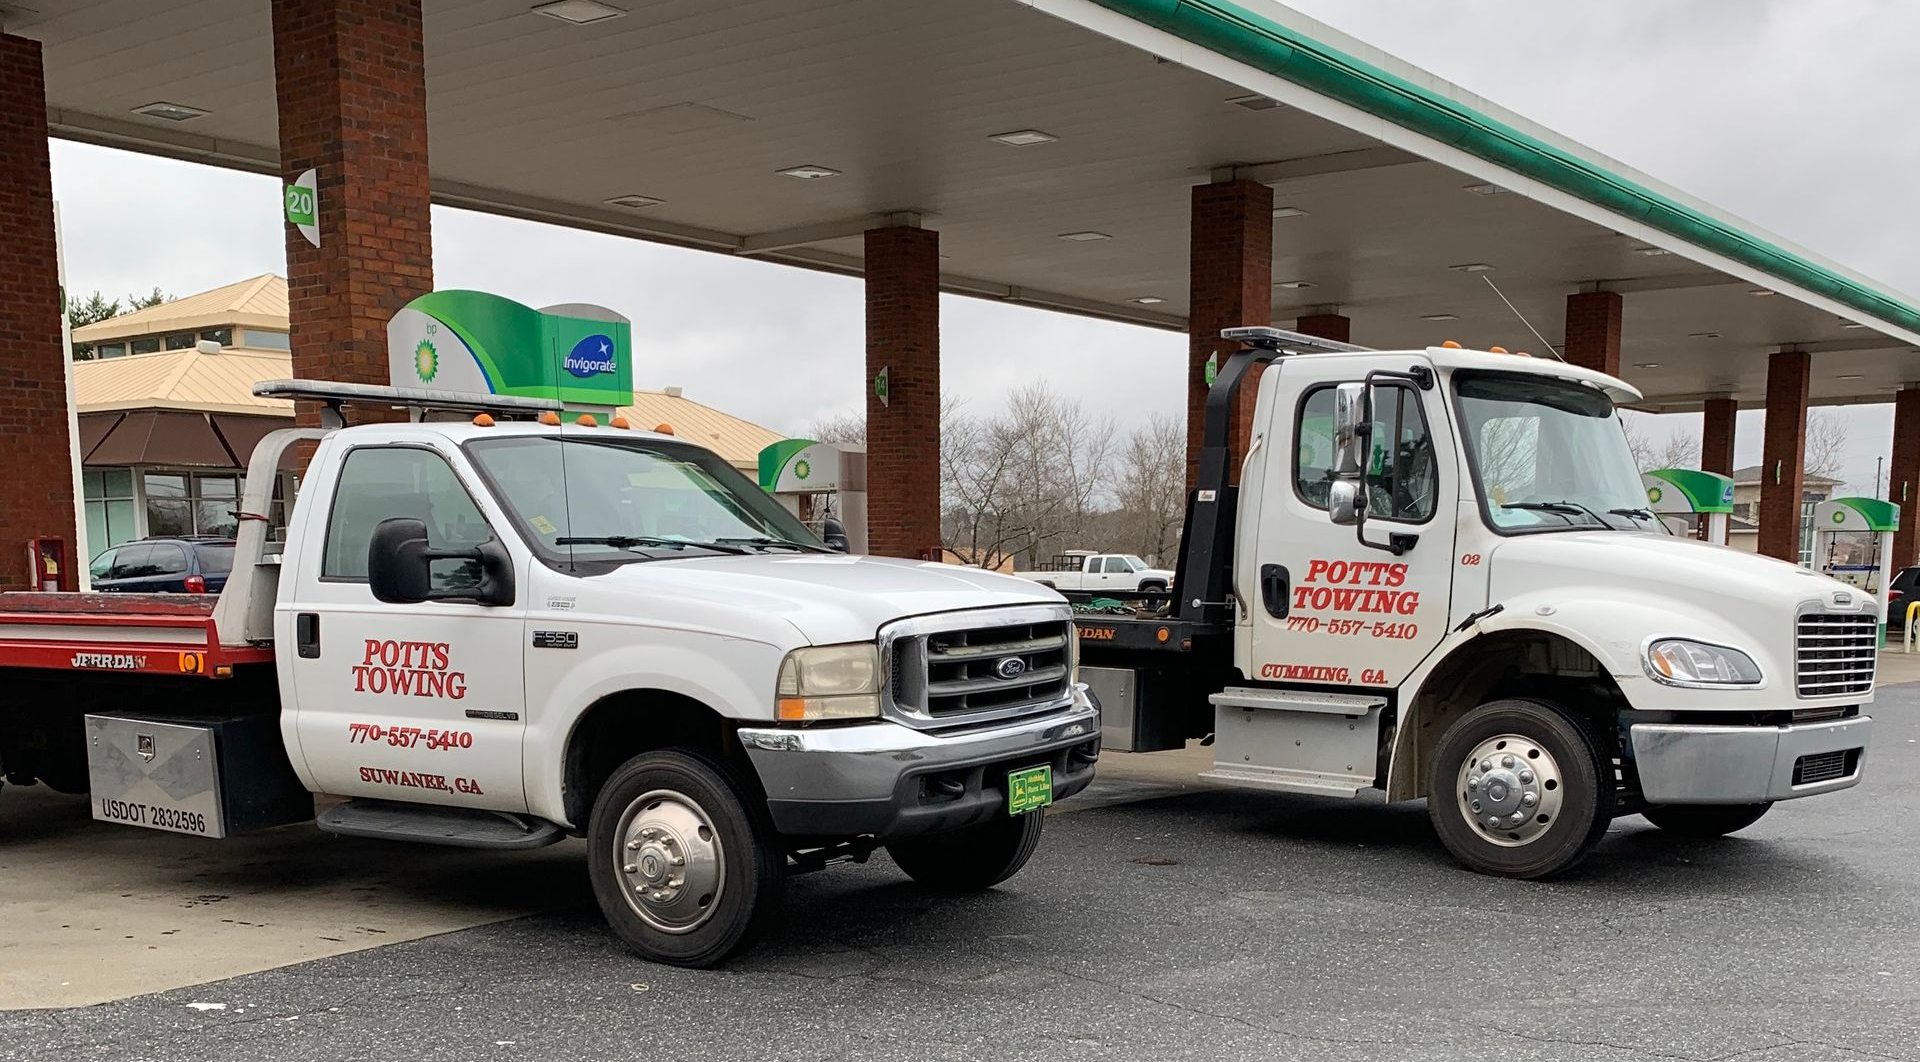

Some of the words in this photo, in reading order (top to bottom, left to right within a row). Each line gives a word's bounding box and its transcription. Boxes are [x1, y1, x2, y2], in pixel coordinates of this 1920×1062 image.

[289, 191, 312, 215] 20
[426, 322, 437, 337] bp
[564, 357, 617, 374] Invigorate
[1461, 554, 1481, 566] 02
[1304, 560, 1408, 587] POTTS
[1293, 587, 1419, 615] TOWING
[533, 631, 577, 644] F-550
[1287, 616, 1418, 640] 770-557-5410
[362, 639, 450, 671] POTTS
[352, 666, 467, 700] TOWING
[1261, 663, 1352, 684] CUMMING,
[1361, 669, 1389, 685] GA.
[349, 723, 473, 751] 770-557-5410
[102, 798, 146, 823] USDOT
[150, 806, 206, 833] 2832596
